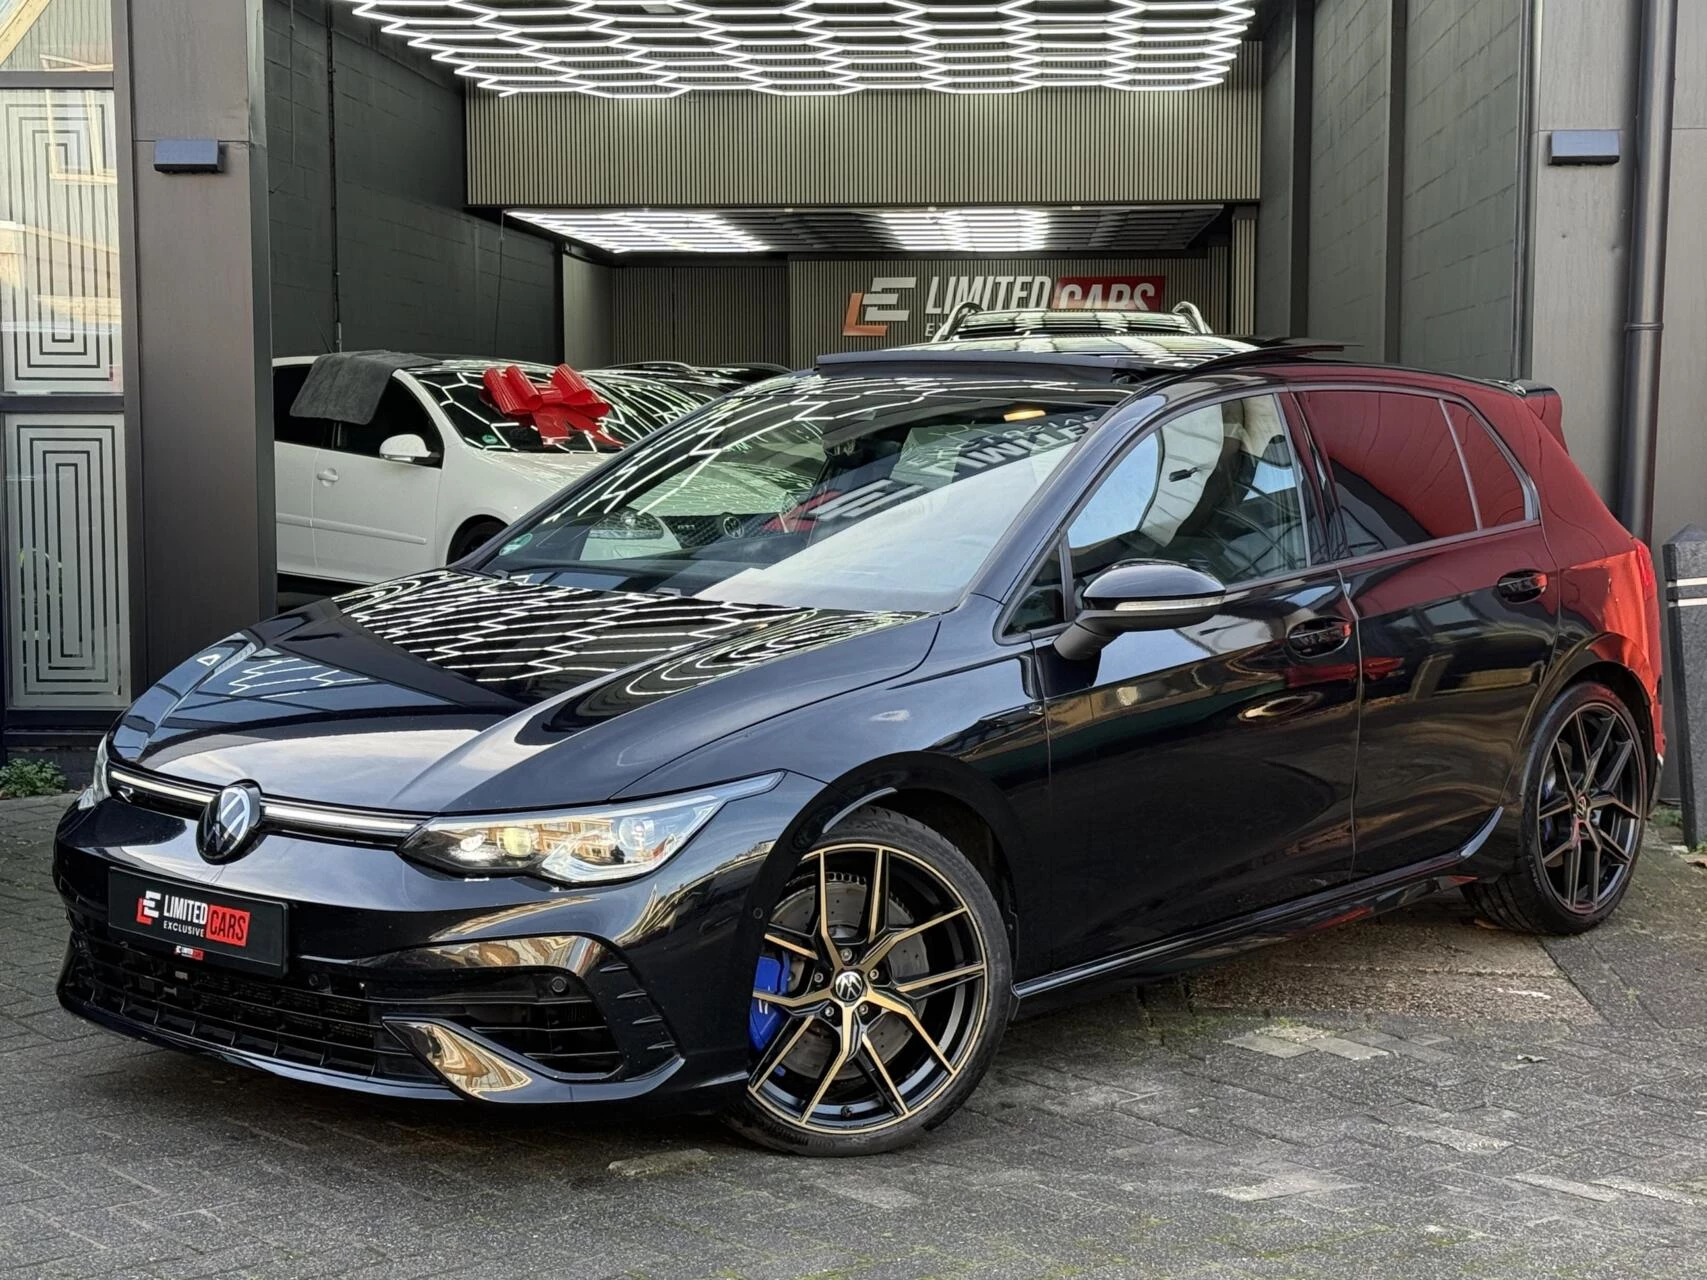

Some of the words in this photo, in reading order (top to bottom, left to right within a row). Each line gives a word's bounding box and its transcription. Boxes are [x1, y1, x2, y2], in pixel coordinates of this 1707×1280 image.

[925, 275, 1052, 314] LIMITED
[1058, 283, 1155, 311] CARS
[163, 894, 209, 926] LIMITED
[209, 909, 247, 942] CARS
[163, 919, 206, 939] EXCLUSIVE
